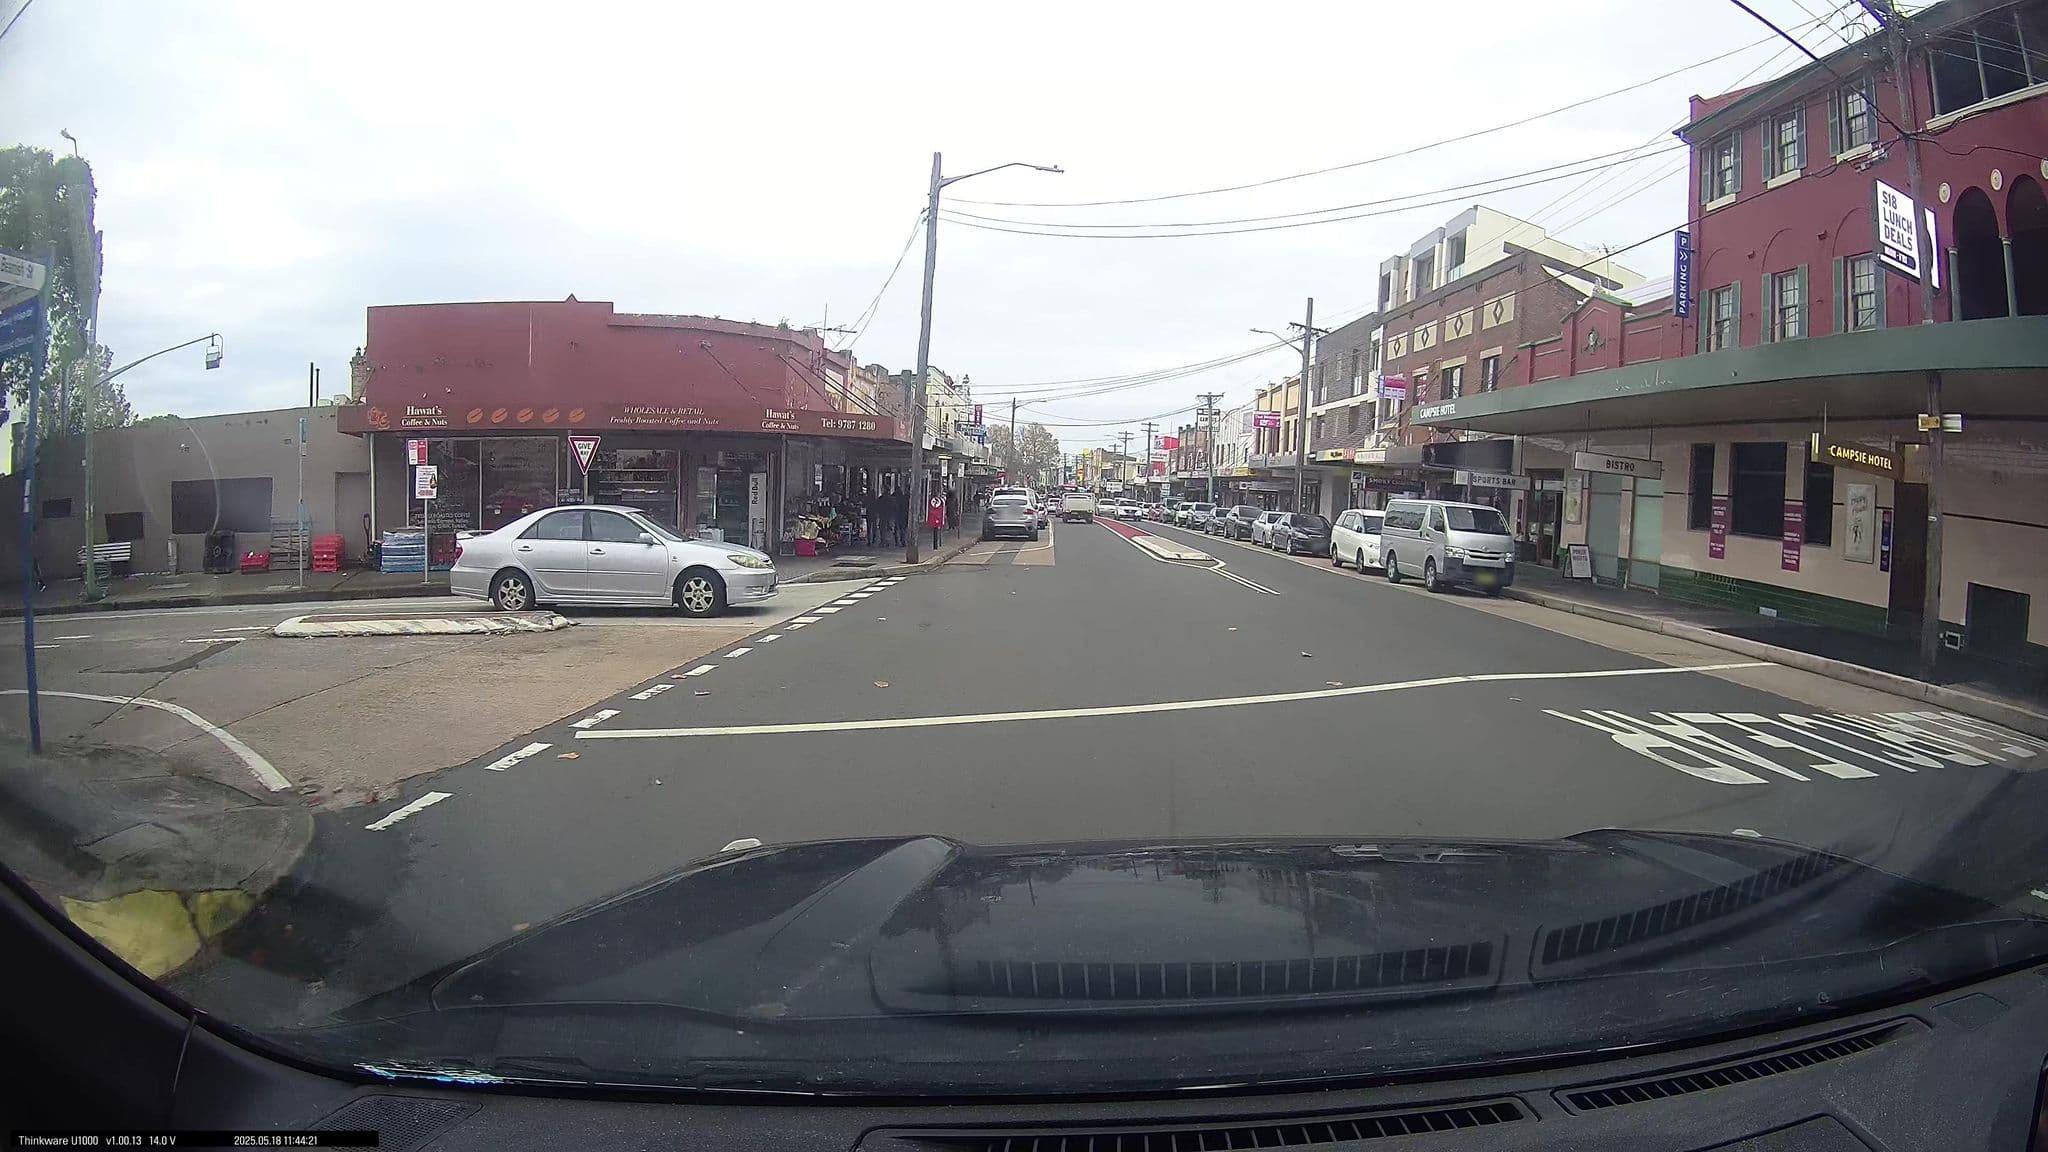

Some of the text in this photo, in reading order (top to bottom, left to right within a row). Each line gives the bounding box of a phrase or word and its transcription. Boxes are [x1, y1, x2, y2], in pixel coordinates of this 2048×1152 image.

[1883, 206, 1913, 235] LUNCH
[1884, 224, 1913, 252] DEALS
[1679, 264, 1687, 314] PARKING
[406, 405, 443, 416] Hawat's
[623, 406, 705, 416] WHOLESALE & RETAIL
[765, 408, 796, 420] Hawat's
[1420, 403, 1457, 419] CAMPSIE HOTEL
[401, 418, 424, 426] Coffee
[431, 418, 448, 426] Nuts
[609, 416, 634, 425] Freshly
[635, 416, 663, 424] Roasted
[664, 417, 686, 426] Coffee
[687, 417, 701, 425] and
[761, 421, 780, 429] Coffee
[821, 418, 876, 431] Tel: 9787 1280
[1830, 445, 1892, 470] CAMPSIE HOTEL
[1605, 459, 1635, 472] BISTRO
[1472, 474, 1516, 486] SPORTS BAR
